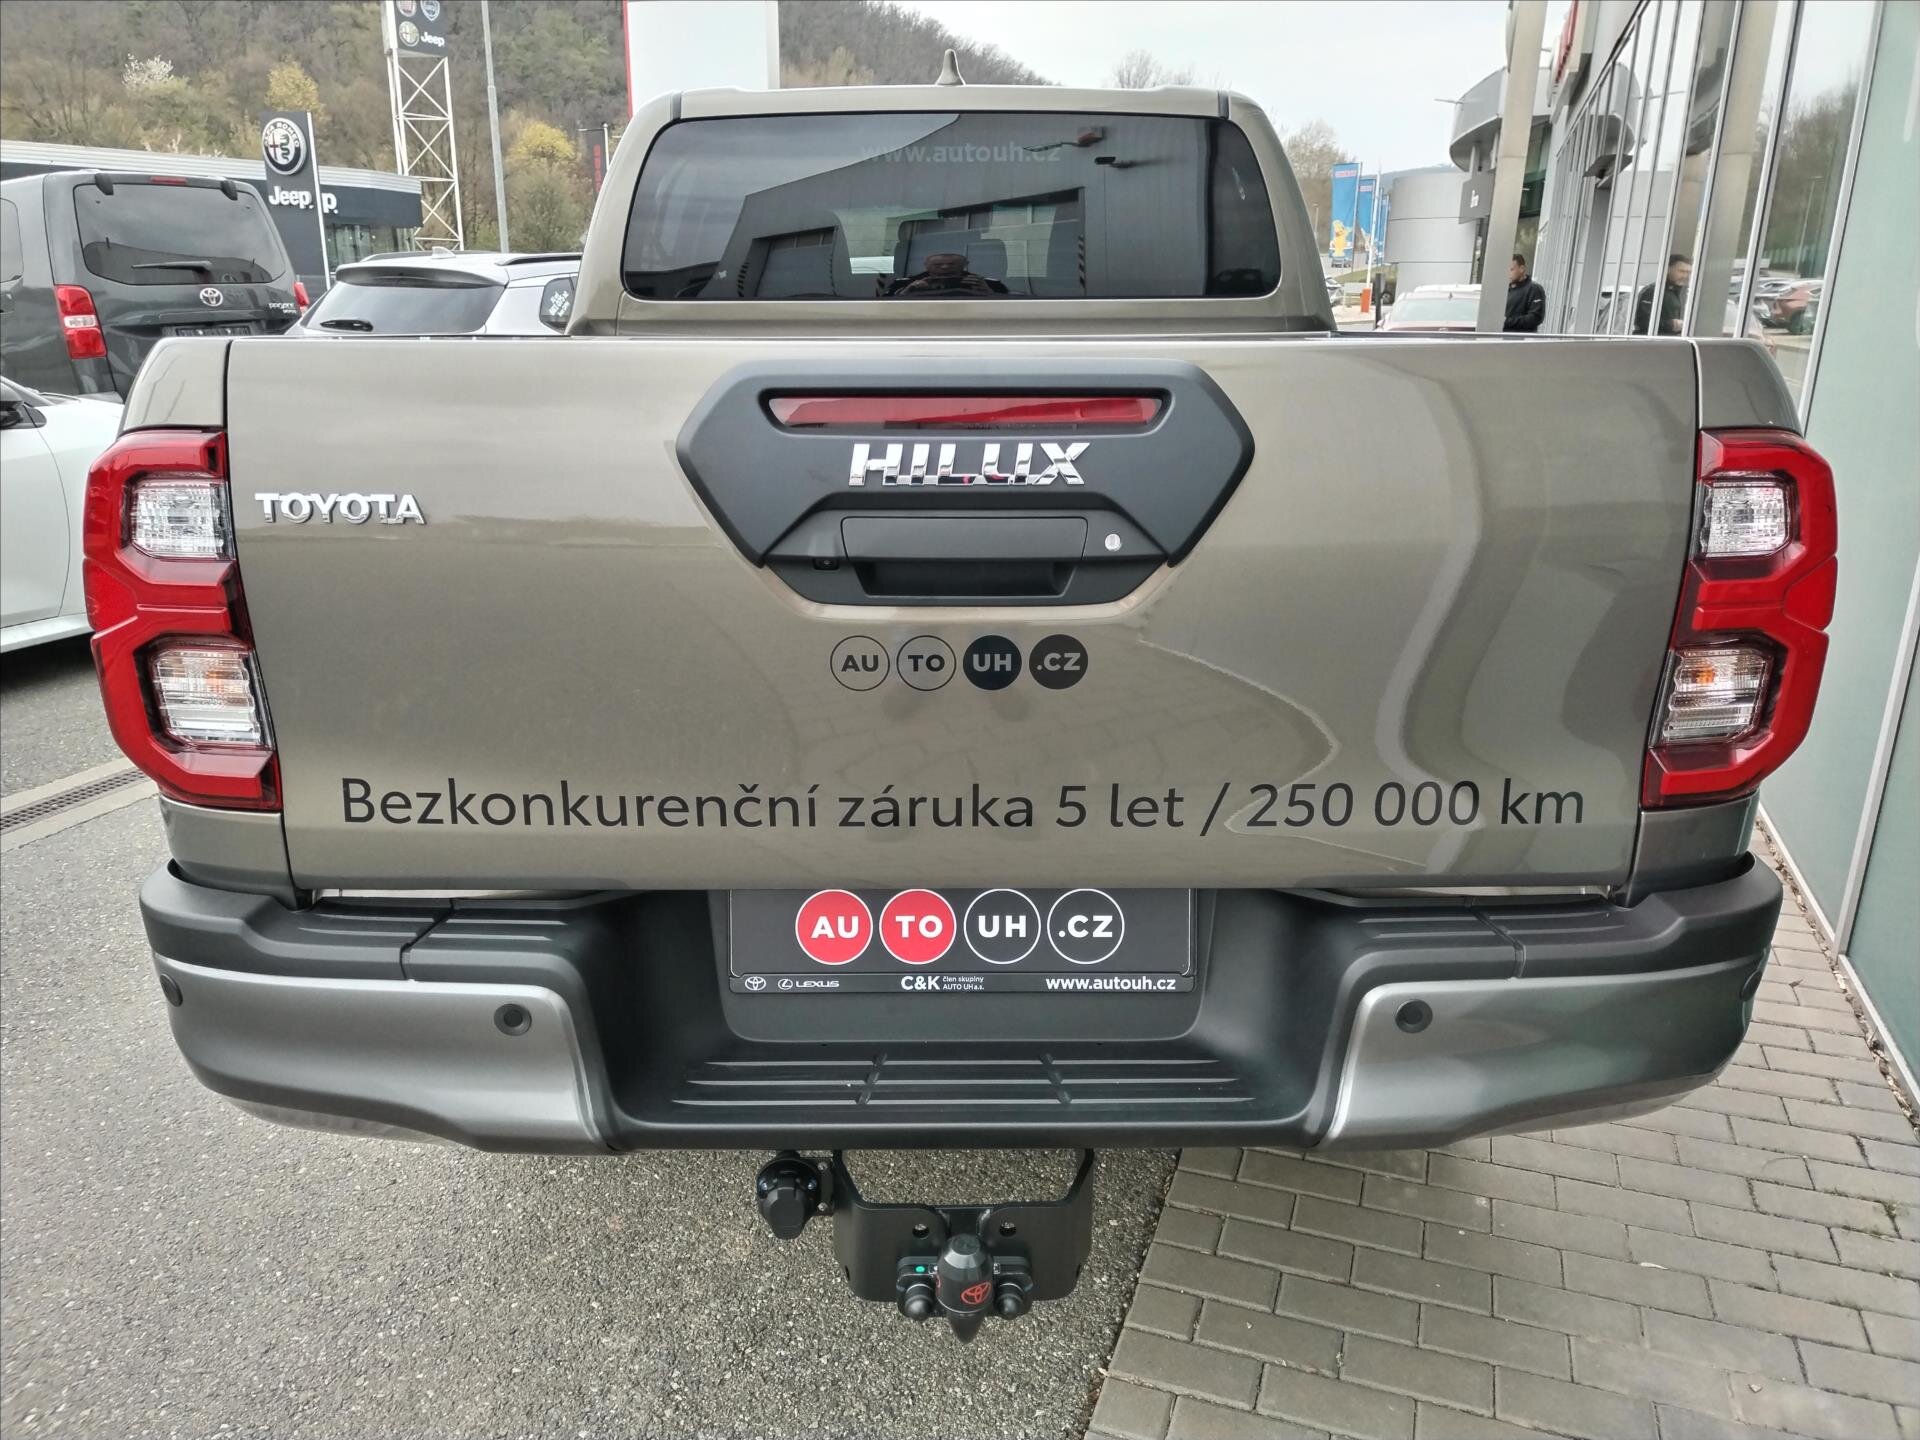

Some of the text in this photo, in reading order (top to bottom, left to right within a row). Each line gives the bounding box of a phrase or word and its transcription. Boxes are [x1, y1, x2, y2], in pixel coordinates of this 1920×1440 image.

[861, 142, 1061, 163] www.autouh.cz
[849, 442, 1090, 486] HILUX
[254, 492, 426, 525] TOYOTA
[341, 777, 1585, 837] Bezkonkurenční záruka 5 let / 250 000 km
[795, 980, 840, 988] LEXUS
[900, 975, 941, 991] C&K
[958, 975, 985, 984] skupiny
[1046, 975, 1177, 991] www.autouh.cz
